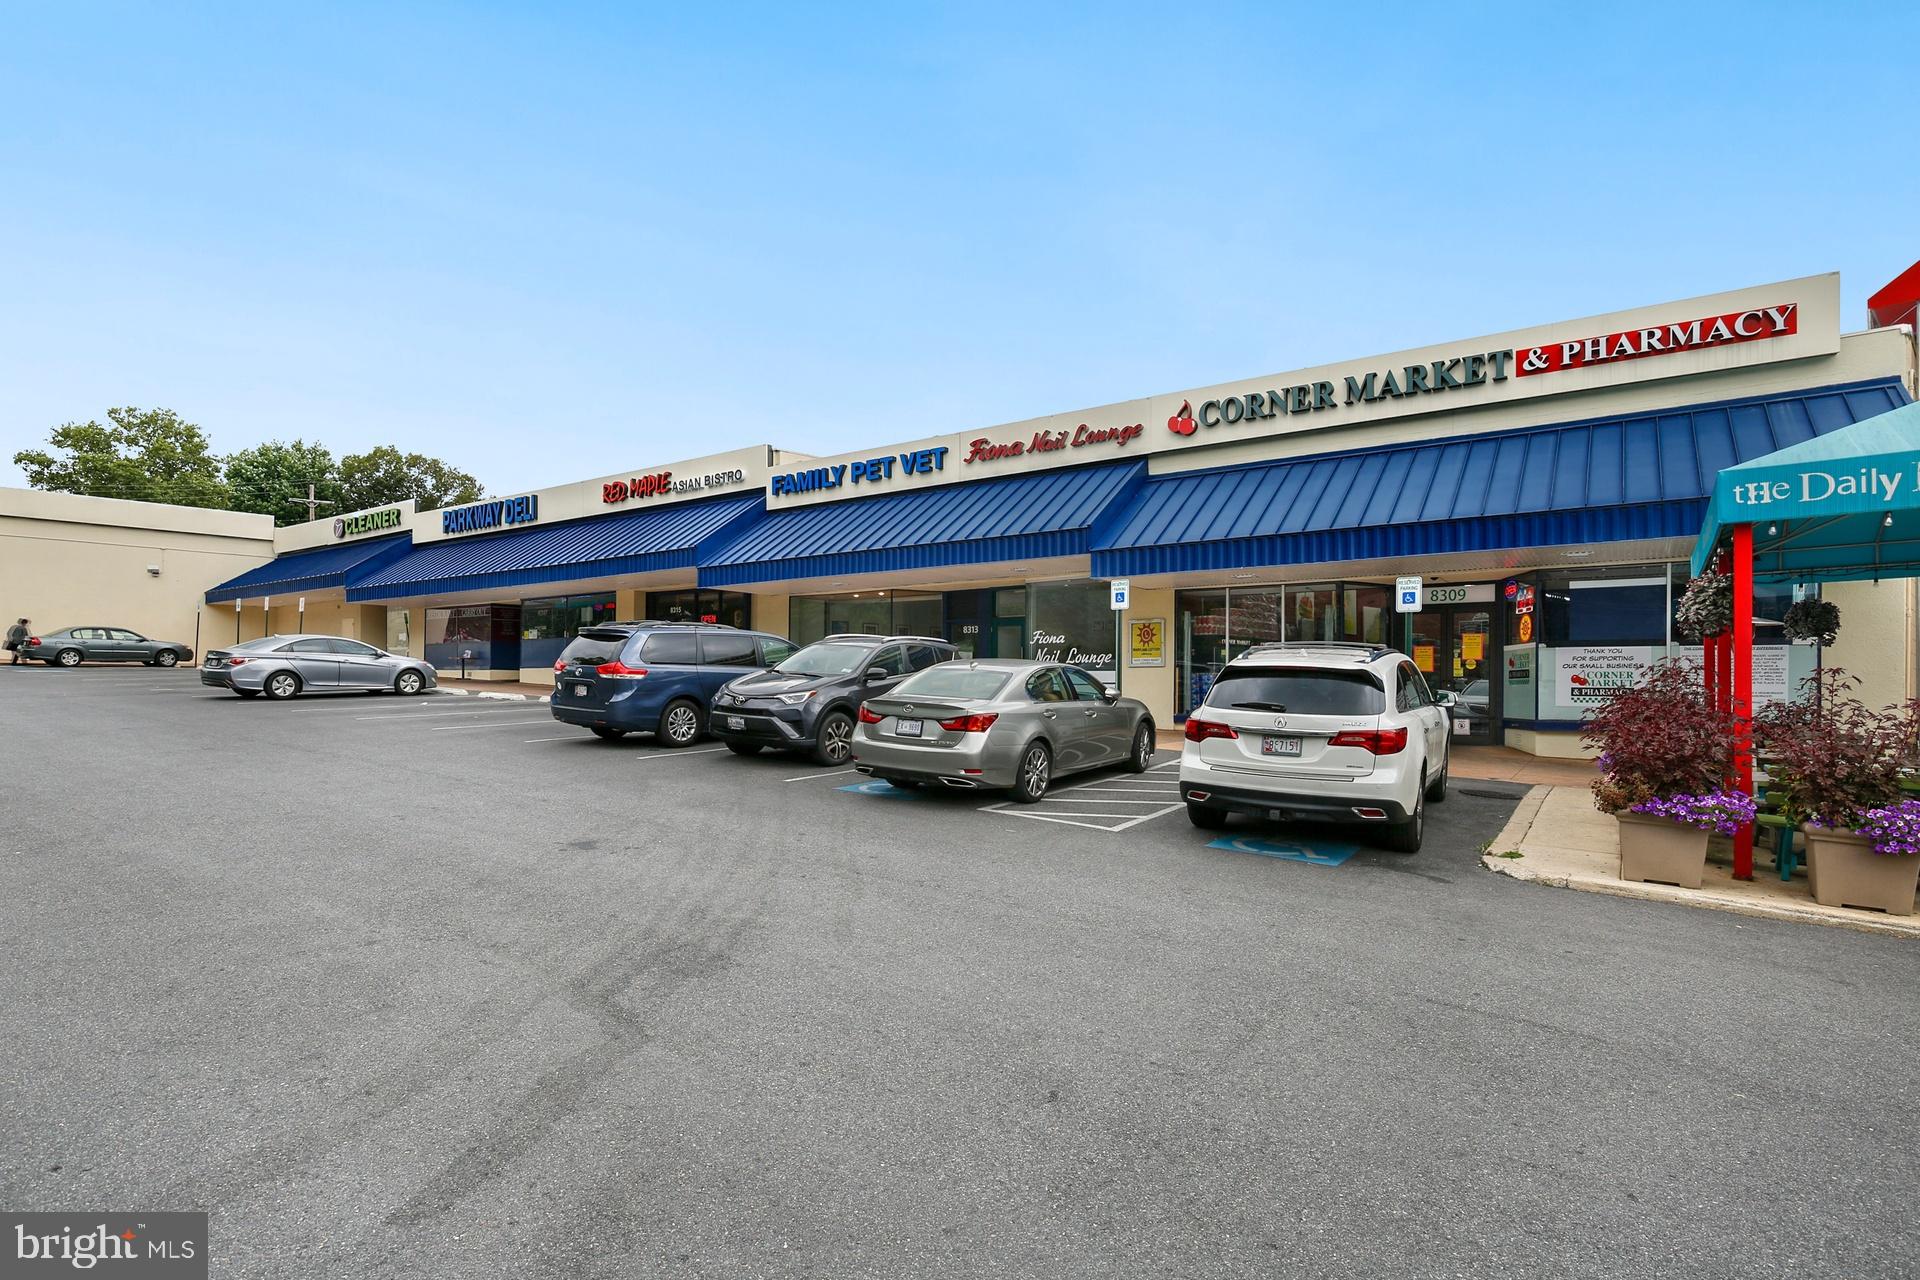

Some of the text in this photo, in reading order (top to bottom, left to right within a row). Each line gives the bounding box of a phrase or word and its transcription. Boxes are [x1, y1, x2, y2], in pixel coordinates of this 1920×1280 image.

[1199, 303, 1796, 428] CORNER MARKET & PHARMACY
[963, 423, 1145, 465] Fiona Nail Lounge
[771, 446, 949, 497] FAMILY PET VET
[602, 469, 744, 504] RED MAPLE ASIAN BISTRO
[1798, 468, 1902, 503] Daily
[344, 508, 401, 534] CLEANER
[442, 495, 538, 533] PARKWAY DELI
[1430, 588, 1467, 602] 8309
[963, 625, 979, 634] 8313
[1030, 630, 1066, 645] Fiona
[1035, 647, 1113, 668] Nail Lounge
[1587, 671, 1634, 679] CORNER
[1582, 688, 1633, 696] PHARMAC
